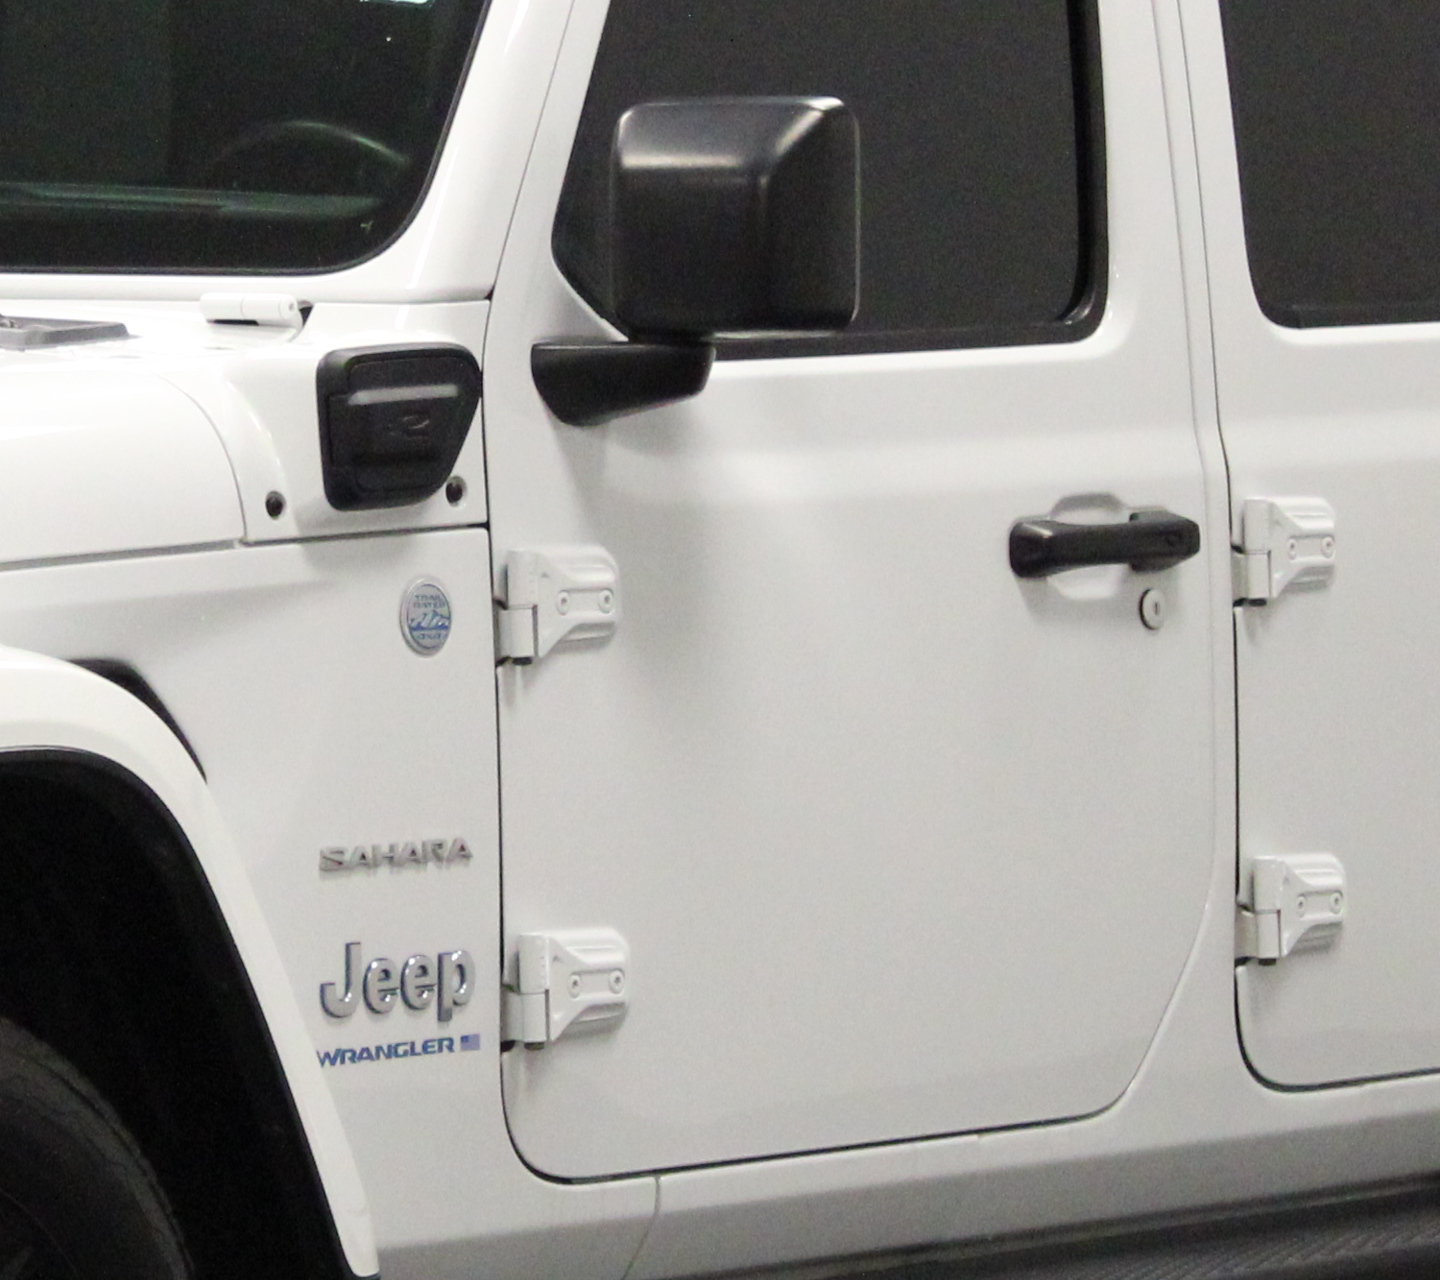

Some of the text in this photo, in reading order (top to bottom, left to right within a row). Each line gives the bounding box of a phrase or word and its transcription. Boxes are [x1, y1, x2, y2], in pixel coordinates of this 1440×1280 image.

[319, 837, 473, 874] SAHARA
[320, 941, 476, 1022] Jeep
[317, 1036, 456, 1067] WRANGLER
